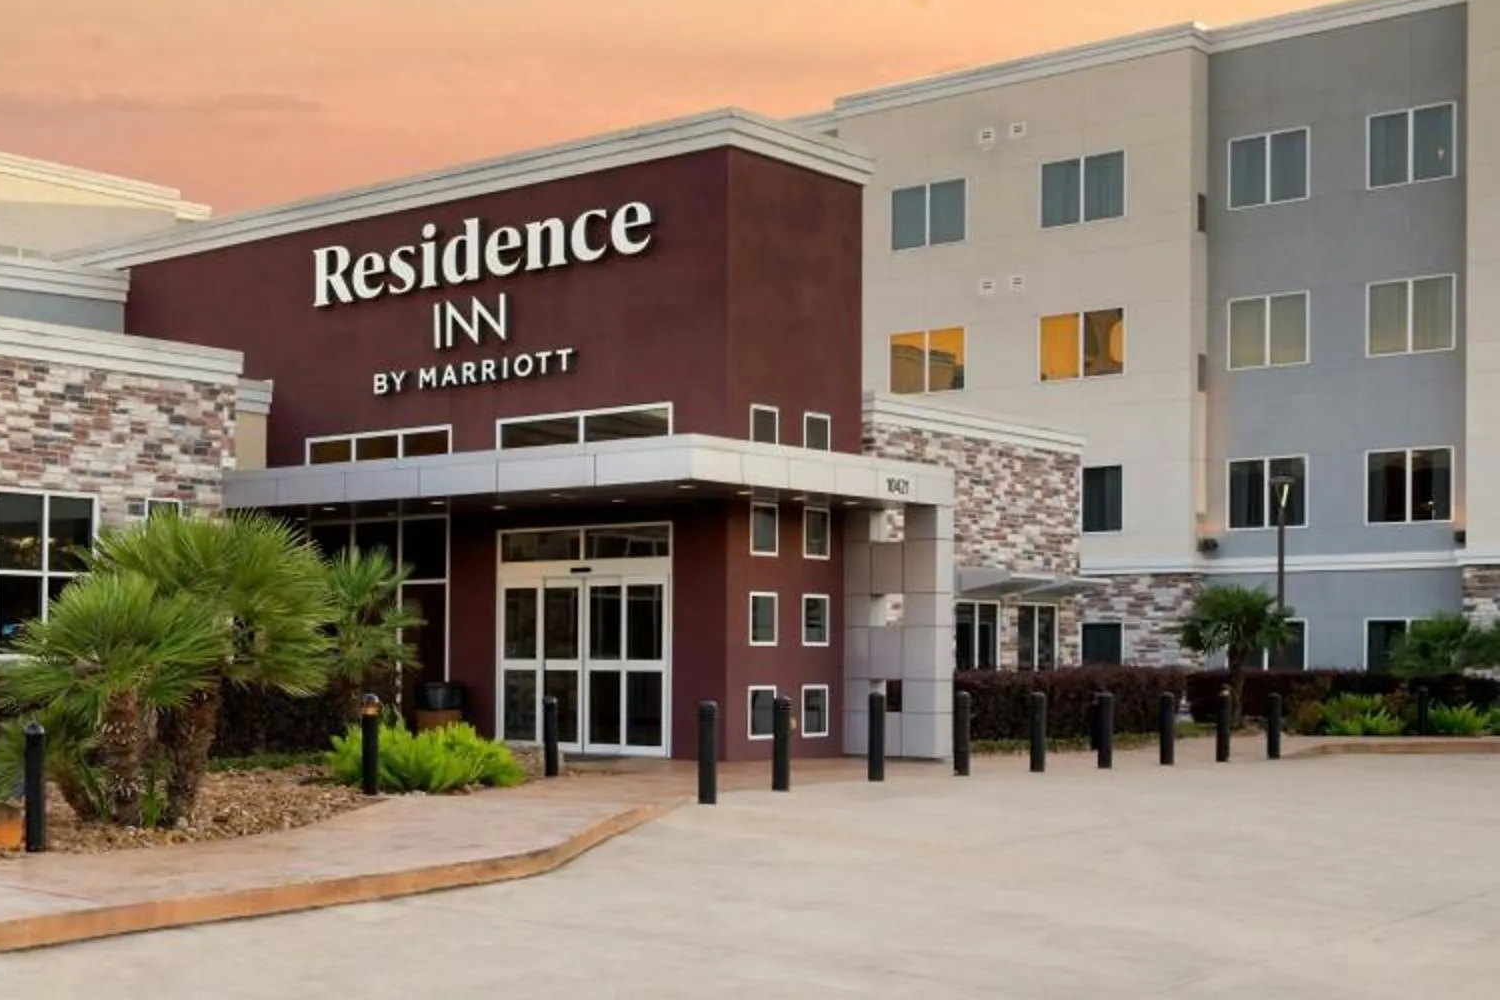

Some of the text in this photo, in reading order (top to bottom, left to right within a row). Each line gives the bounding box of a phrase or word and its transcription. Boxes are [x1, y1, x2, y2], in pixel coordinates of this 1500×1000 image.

[312, 201, 653, 307] Residence
[433, 293, 507, 349] INN
[373, 348, 574, 396] BY MARRIOTT
